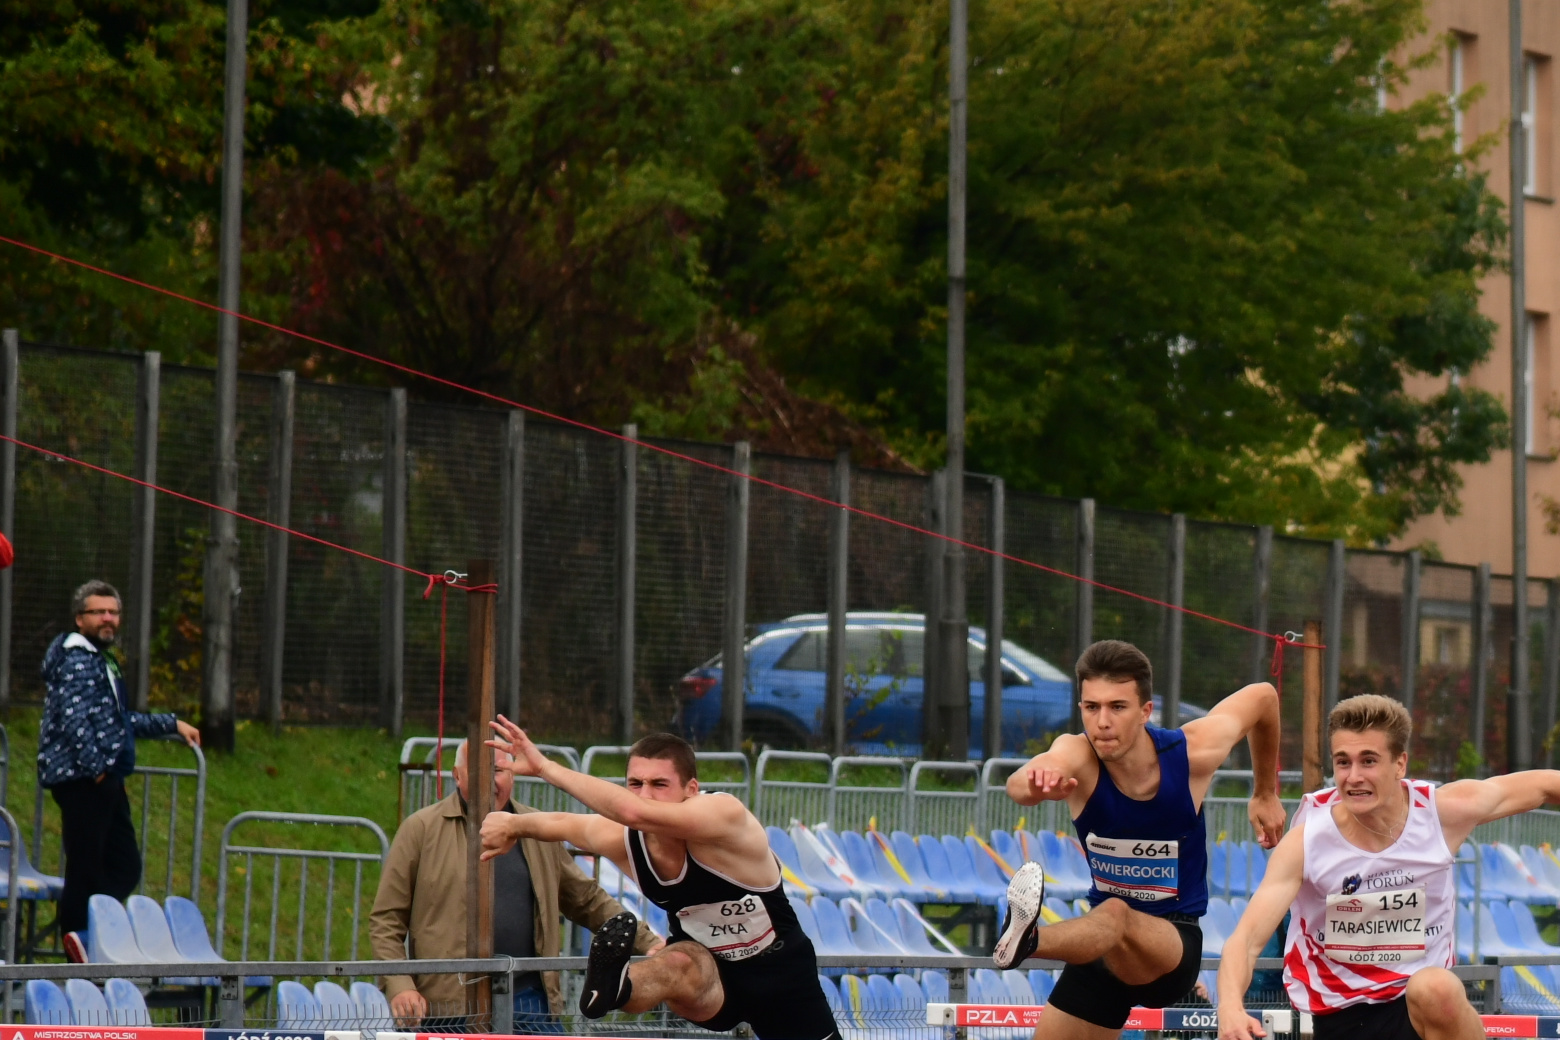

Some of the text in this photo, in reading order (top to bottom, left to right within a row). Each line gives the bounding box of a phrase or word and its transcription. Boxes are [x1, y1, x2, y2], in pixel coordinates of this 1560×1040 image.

[1132, 842, 1171, 857] 664
[1090, 857, 1175, 878] ŚWIERGOCKI
[1368, 868, 1403, 878] MIASTO
[1363, 871, 1415, 890] TORUŃ
[1109, 886, 1132, 897] ŁÓDŹ
[1134, 891, 1155, 900] 2020
[720, 898, 756, 916] 628
[1379, 892, 1418, 910] 154
[709, 923, 748, 937] ŻYŁA
[1330, 918, 1422, 934] TARASIEWICZ
[718, 949, 737, 959] ÓDŹ
[739, 945, 759, 957] 2020
[1348, 952, 1401, 962] ŁÓDŹ 2020
[967, 1010, 1018, 1023] PZLA
[1182, 1011, 1217, 1026] ŁÓDŹ
[33, 1031, 137, 1040] MISTRZOSTWA POLSKI
[1483, 1025, 1517, 1034] FETACH
